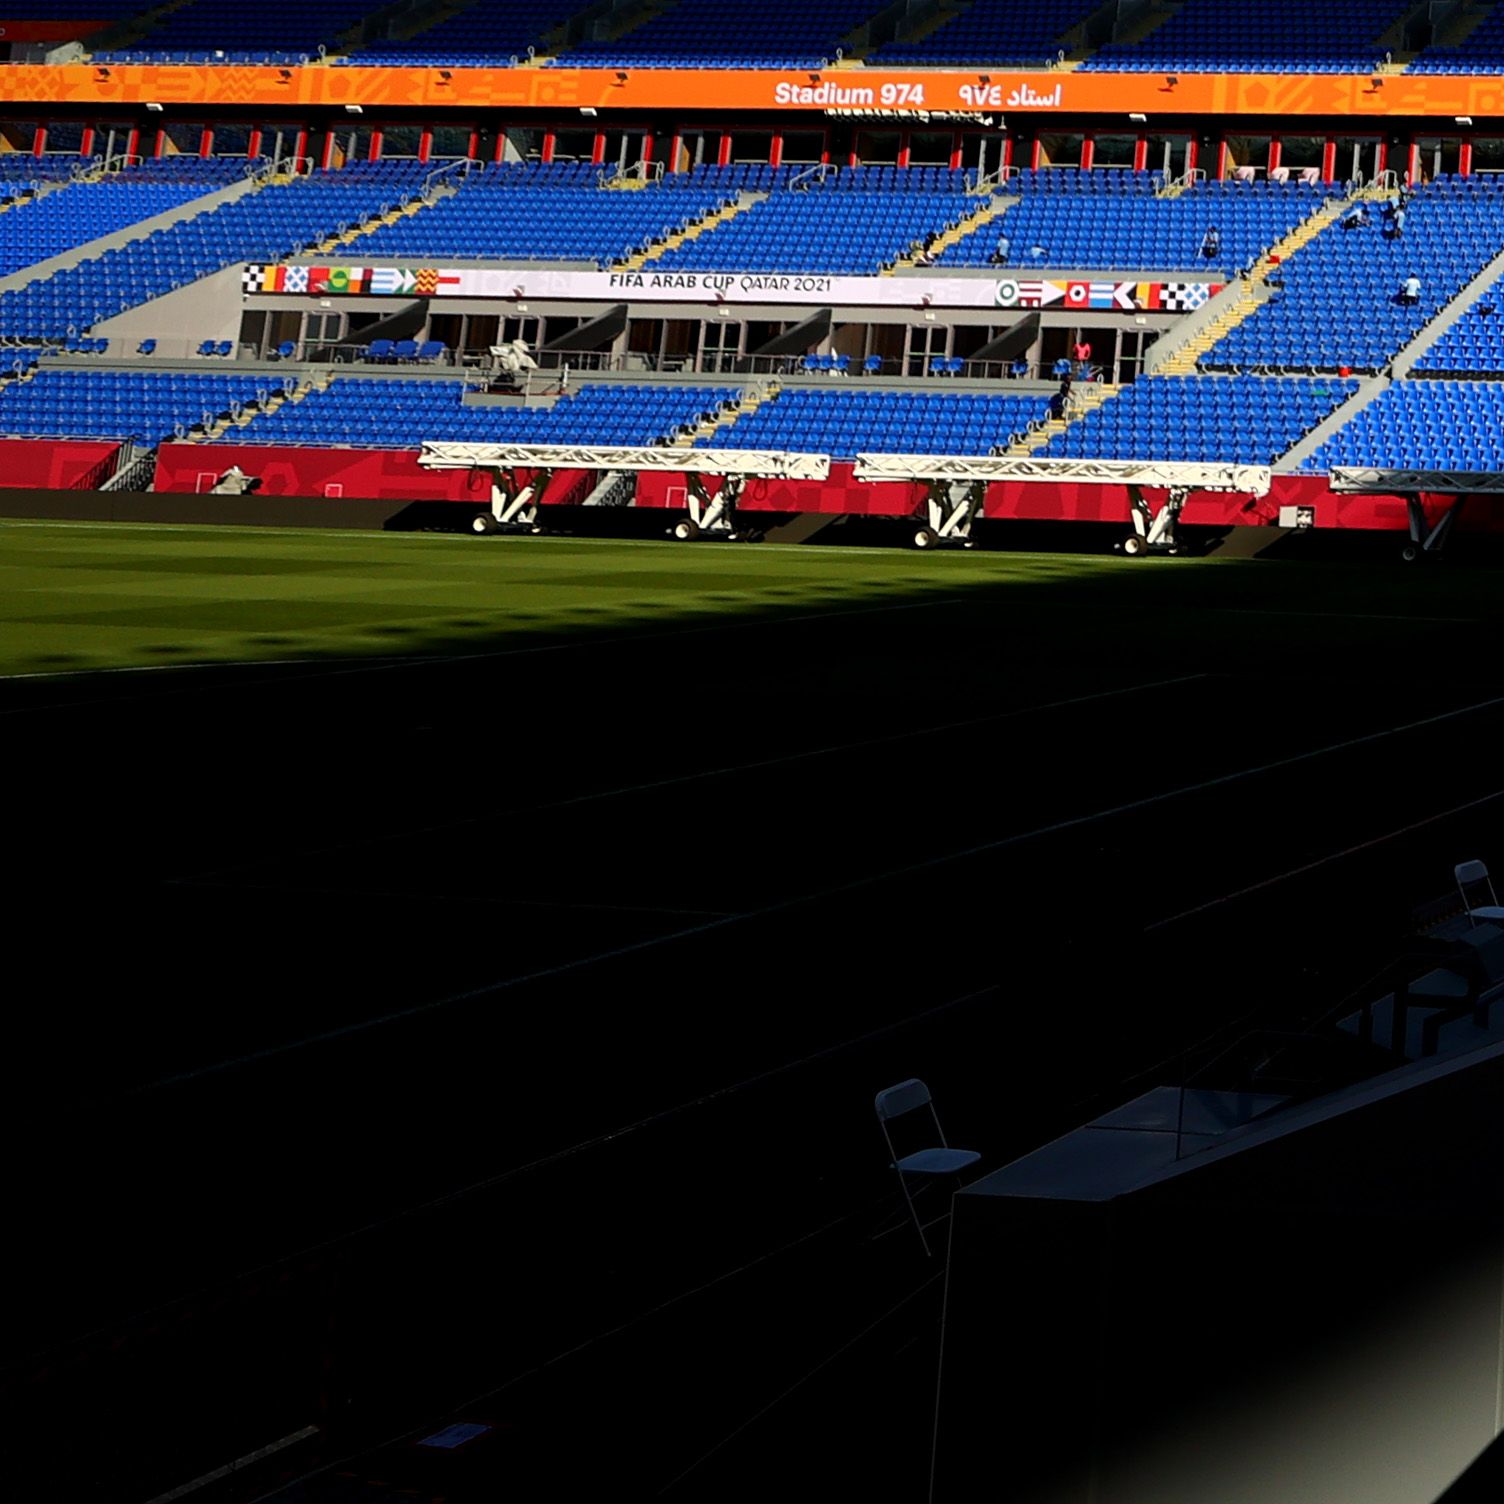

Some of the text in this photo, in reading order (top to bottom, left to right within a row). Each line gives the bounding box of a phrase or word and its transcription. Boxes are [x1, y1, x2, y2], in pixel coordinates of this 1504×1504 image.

[774, 82, 924, 105] Stadium 974
[959, 84, 1061, 106] استاد ٩٧٤
[609, 274, 831, 292] FIFA ARAB CUP QATAR 2021
